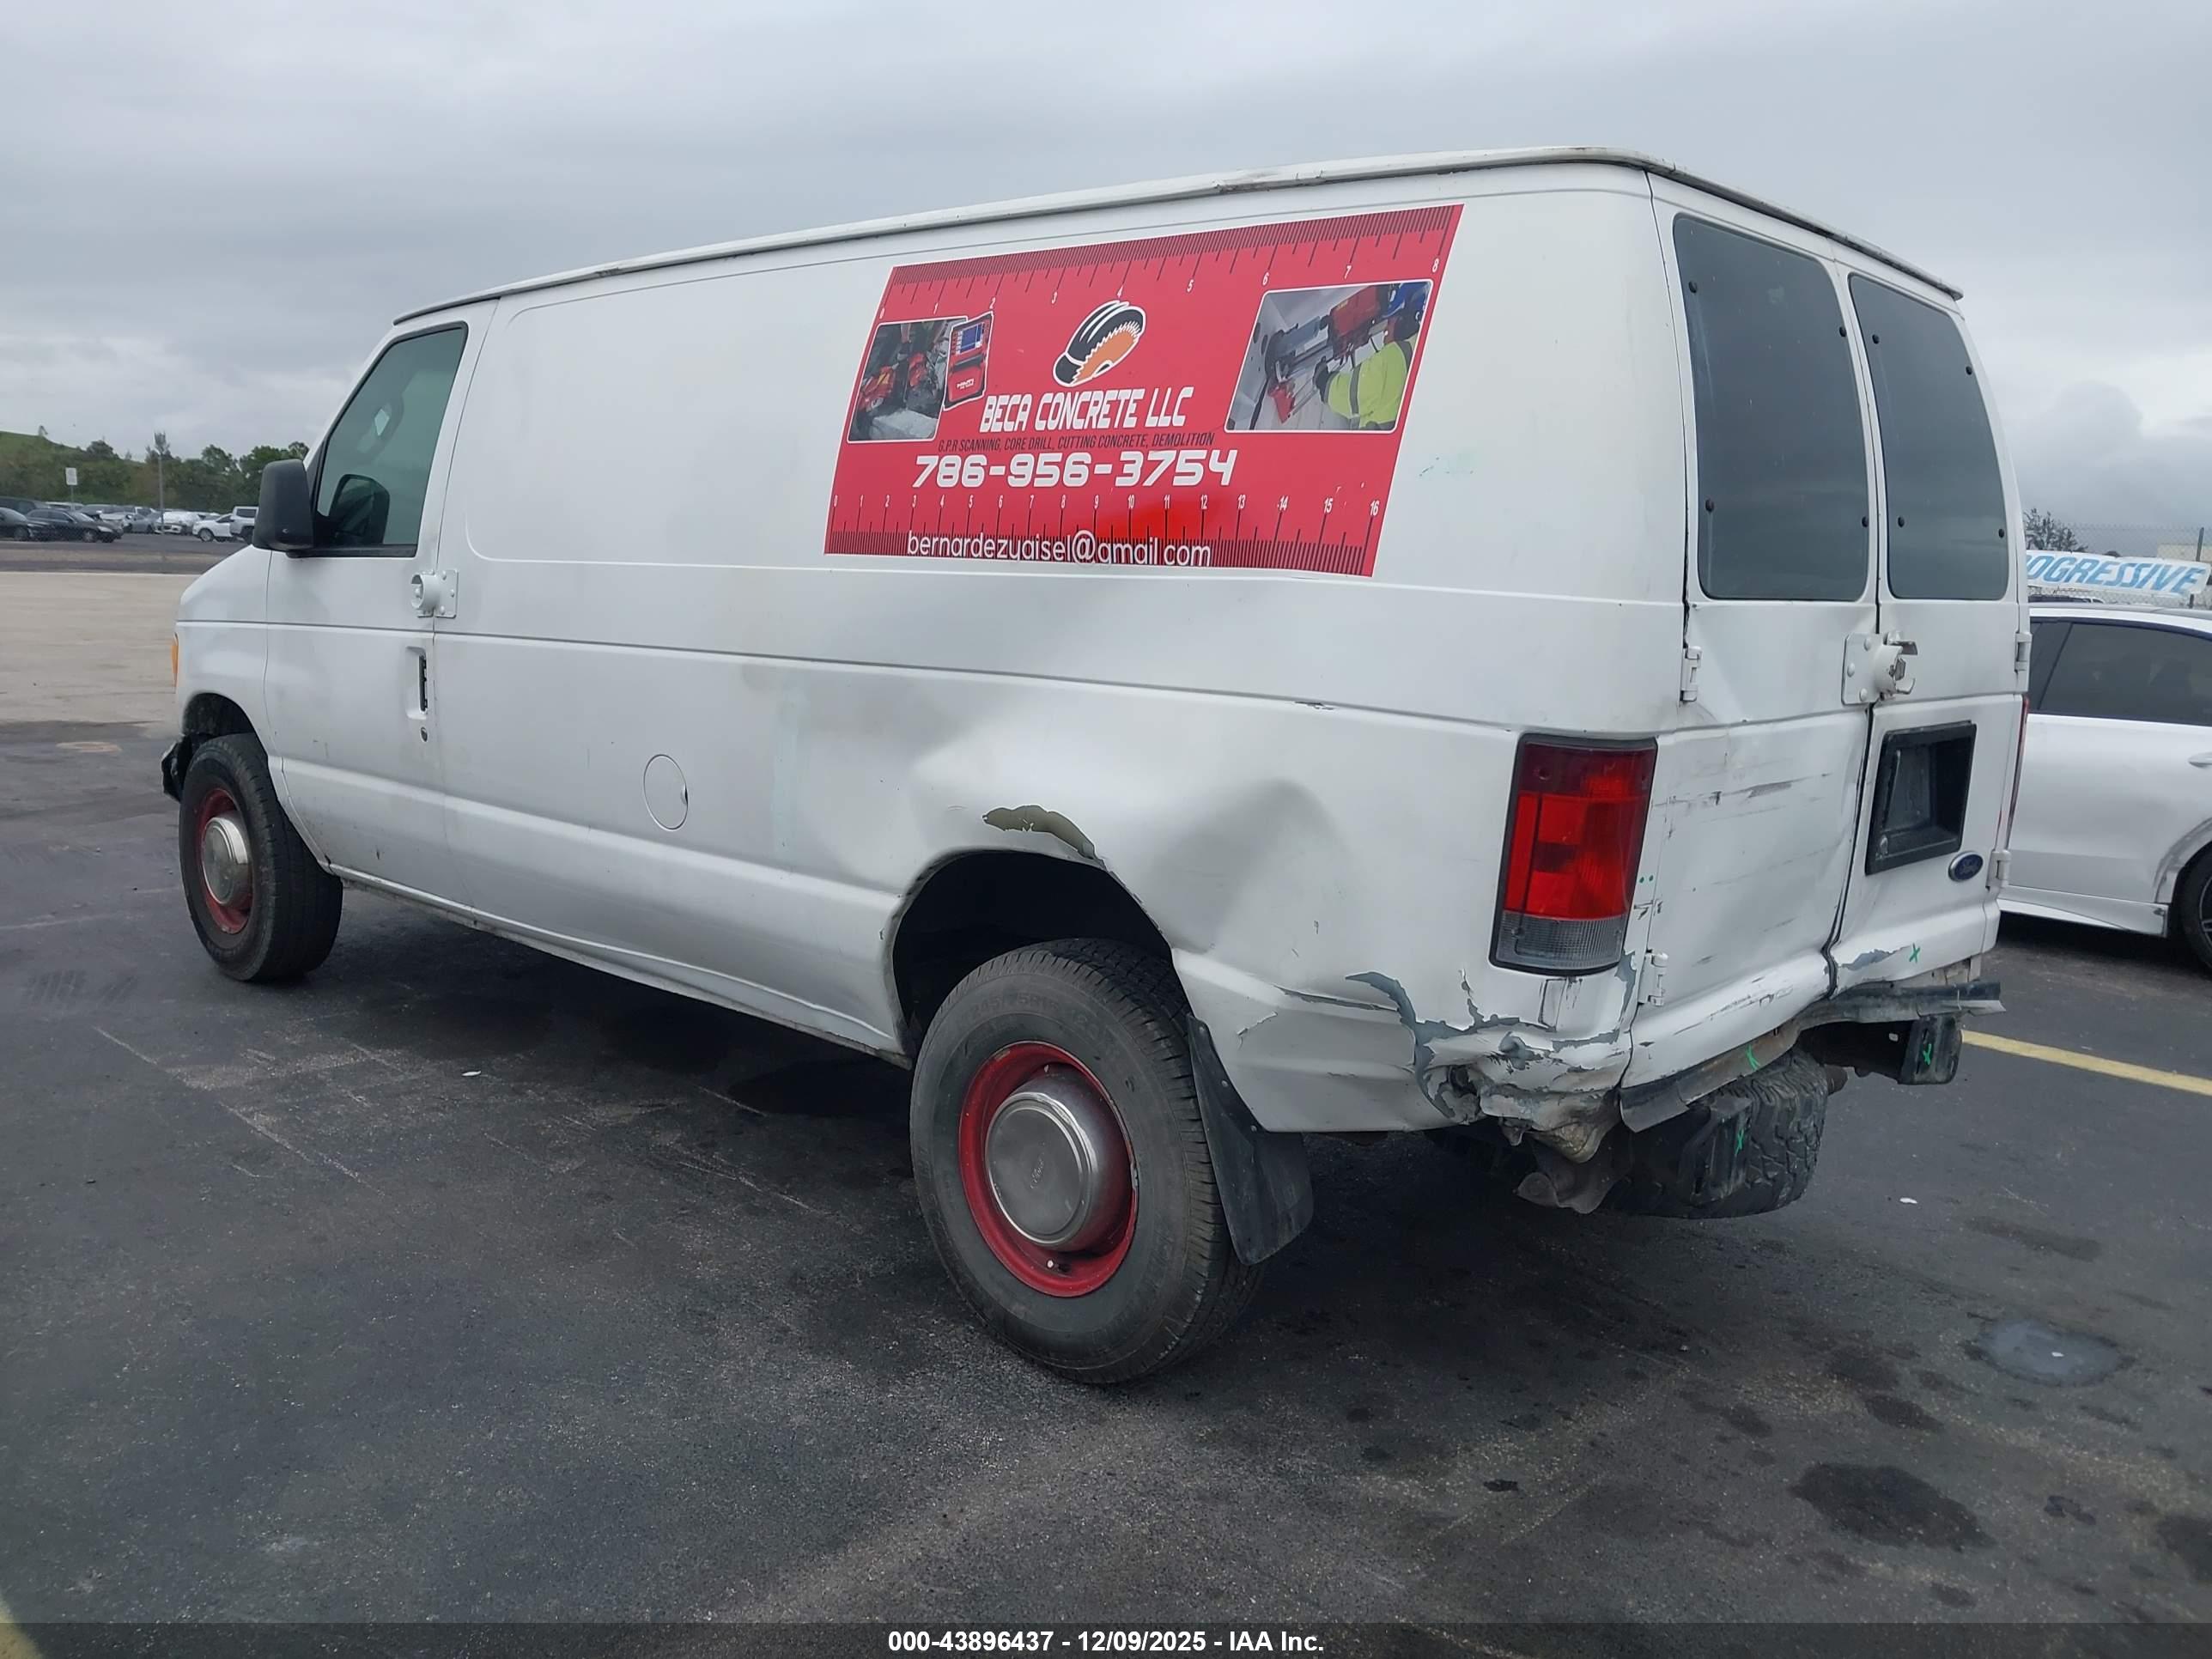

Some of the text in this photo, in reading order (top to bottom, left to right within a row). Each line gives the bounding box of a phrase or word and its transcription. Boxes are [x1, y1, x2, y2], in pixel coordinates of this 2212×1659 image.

[1116, 284, 1124, 299] 4
[1186, 279, 1194, 293] 5
[1262, 272, 1271, 286] 6
[1345, 265, 1352, 279] 7
[1431, 258, 1440, 273] 8
[980, 386, 1194, 432] BECA CONCRETE LLC
[959, 436, 1002, 453] SCANNING,
[1005, 436, 1027, 451] CORE
[1030, 434, 1054, 450] DRILL,
[1057, 435, 1097, 449] CUTTING
[1098, 433, 1149, 448] CONCRETE,
[1152, 432, 1216, 447] DEMOLITION
[912, 451, 1237, 488] 786-956-3754
[884, 495, 890, 507] 2
[912, 495, 917, 507] 3
[939, 495, 945, 507] 4
[968, 495, 974, 507] 5
[998, 495, 1004, 507] 6
[1030, 495, 1035, 508] 7
[1060, 495, 1066, 508] 8
[1094, 495, 1100, 508] 9
[1127, 495, 1135, 508] 10
[1164, 495, 1170, 508] 11
[1200, 495, 1208, 509] 12
[1237, 495, 1246, 509] 13
[1323, 499, 1334, 514] 15
[1370, 501, 1380, 516] 16
[2027, 555, 2206, 593] OGRESSIVE
